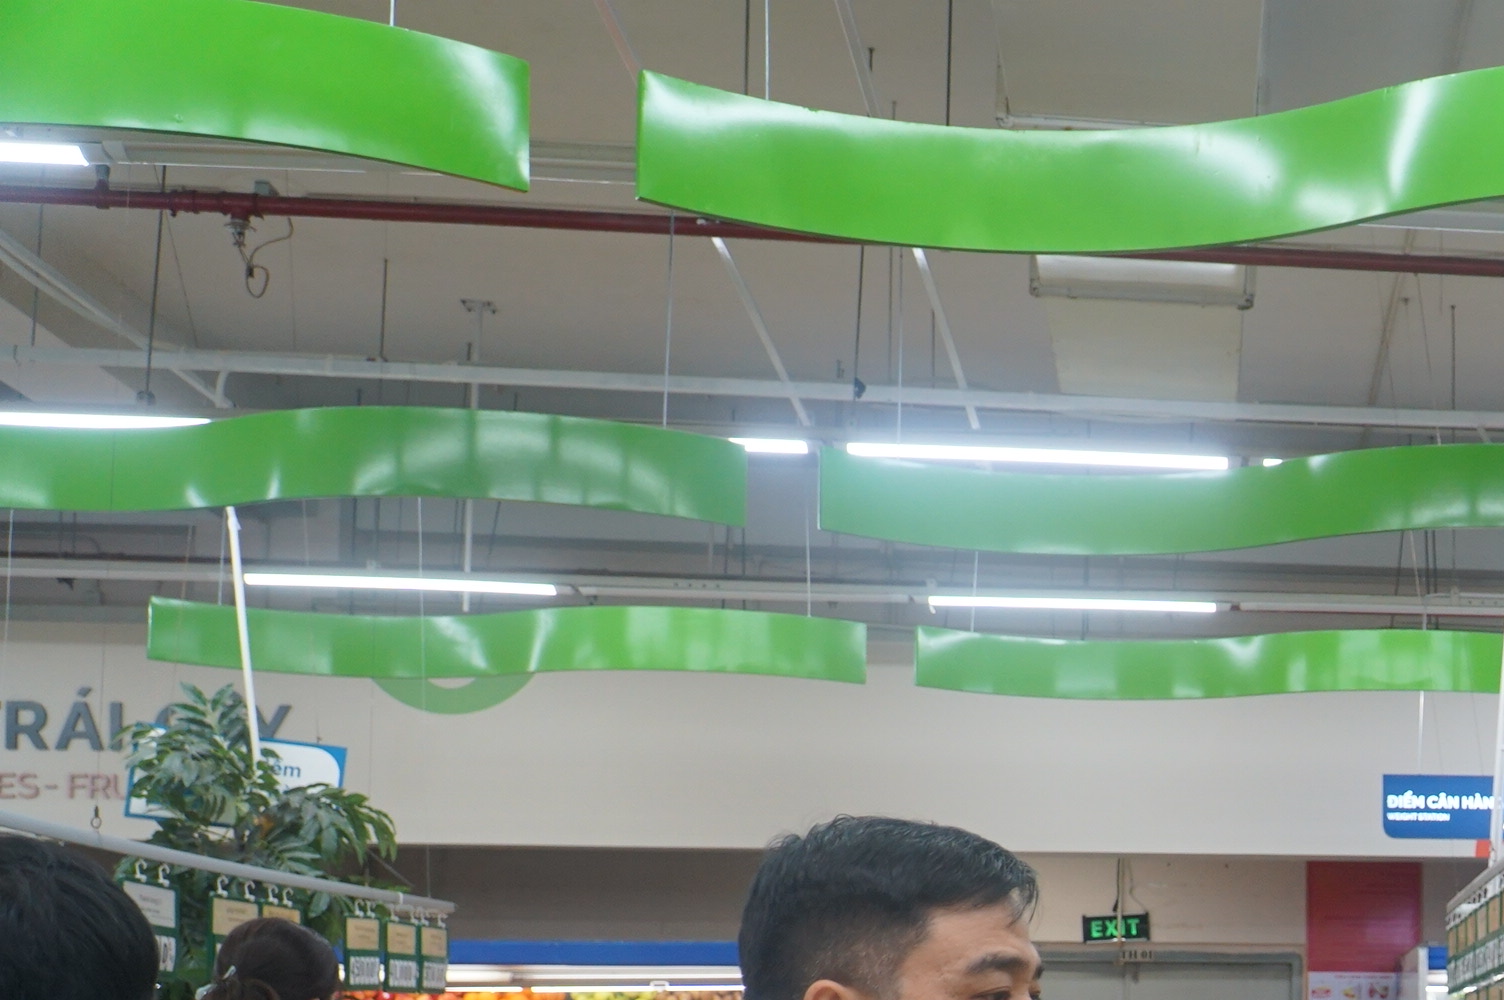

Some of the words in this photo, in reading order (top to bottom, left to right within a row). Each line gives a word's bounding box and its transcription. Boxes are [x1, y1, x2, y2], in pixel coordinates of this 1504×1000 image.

[0, 687, 123, 751] RÁI
[1426, 792, 1460, 809] CÂN
[1090, 917, 1140, 938] EXIT
